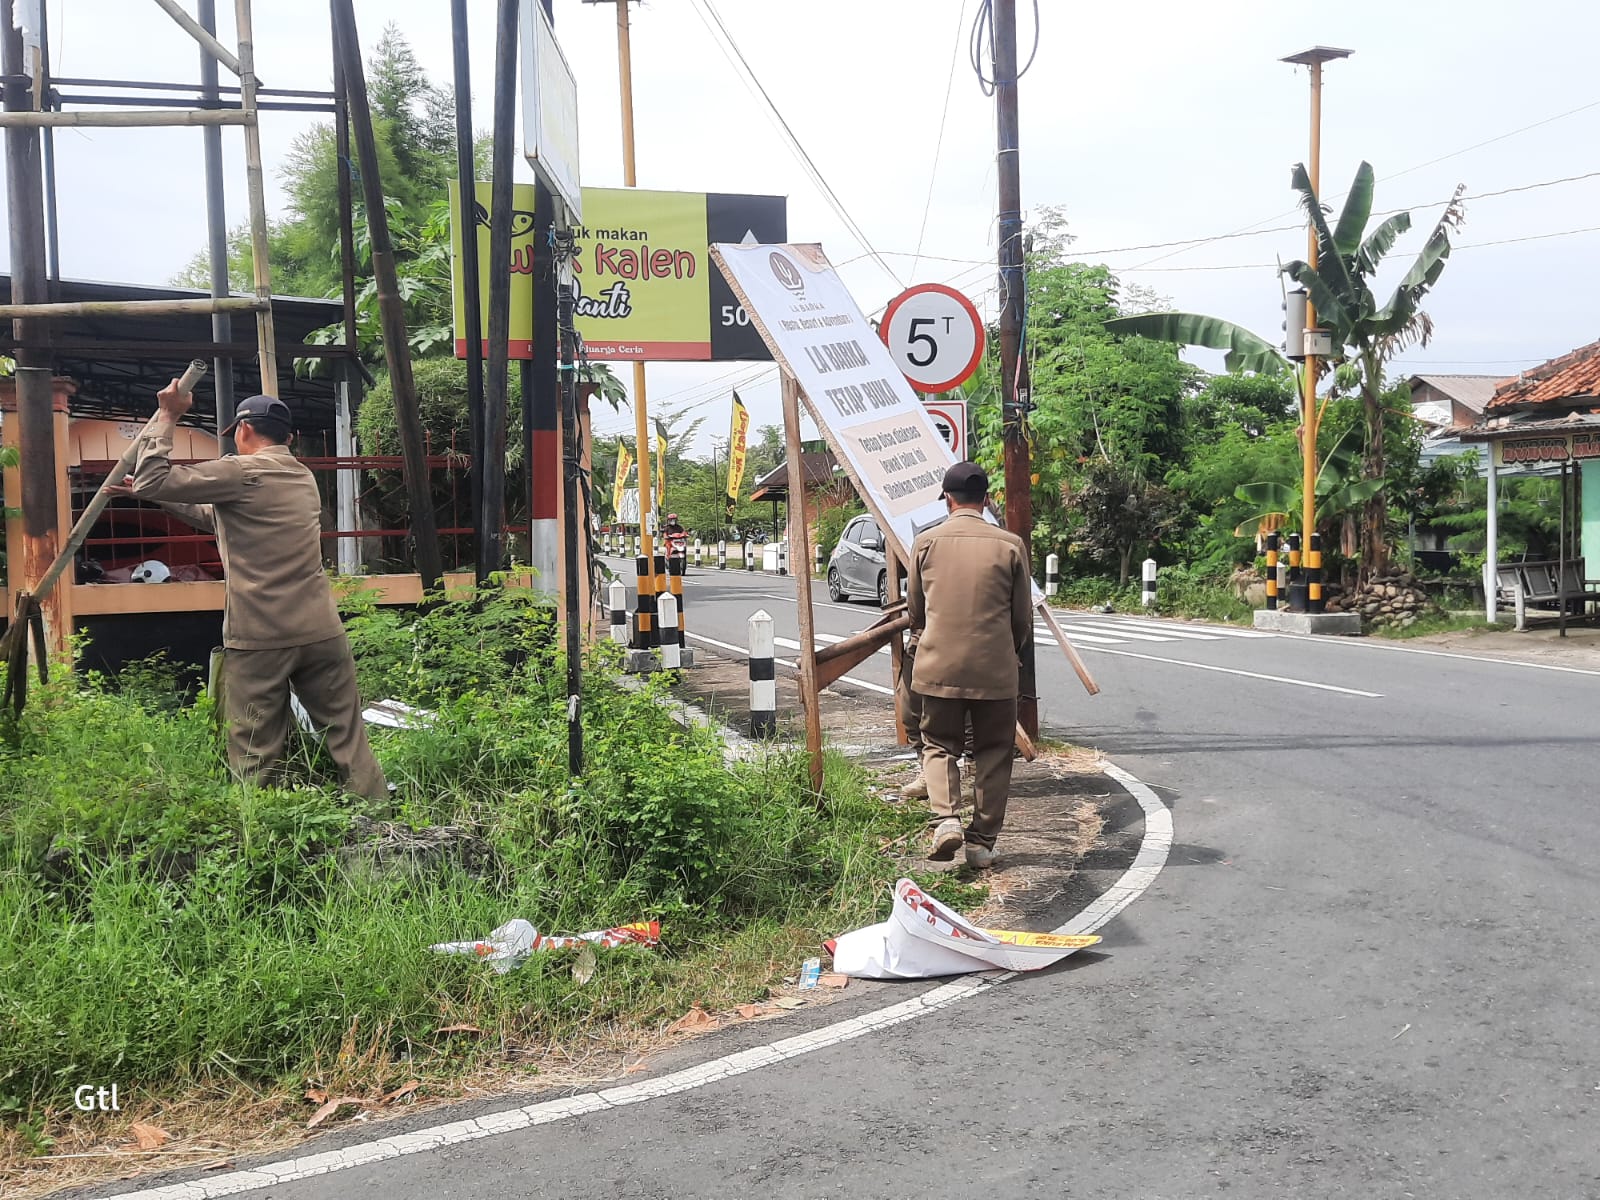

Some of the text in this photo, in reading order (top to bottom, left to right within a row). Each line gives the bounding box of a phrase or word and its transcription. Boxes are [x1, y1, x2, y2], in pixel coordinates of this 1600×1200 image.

[596, 227, 648, 241] makan
[721, 305, 750, 327] 50
[804, 340, 870, 374] LA BARKA
[824, 378, 901, 417] TETAP BUKA
